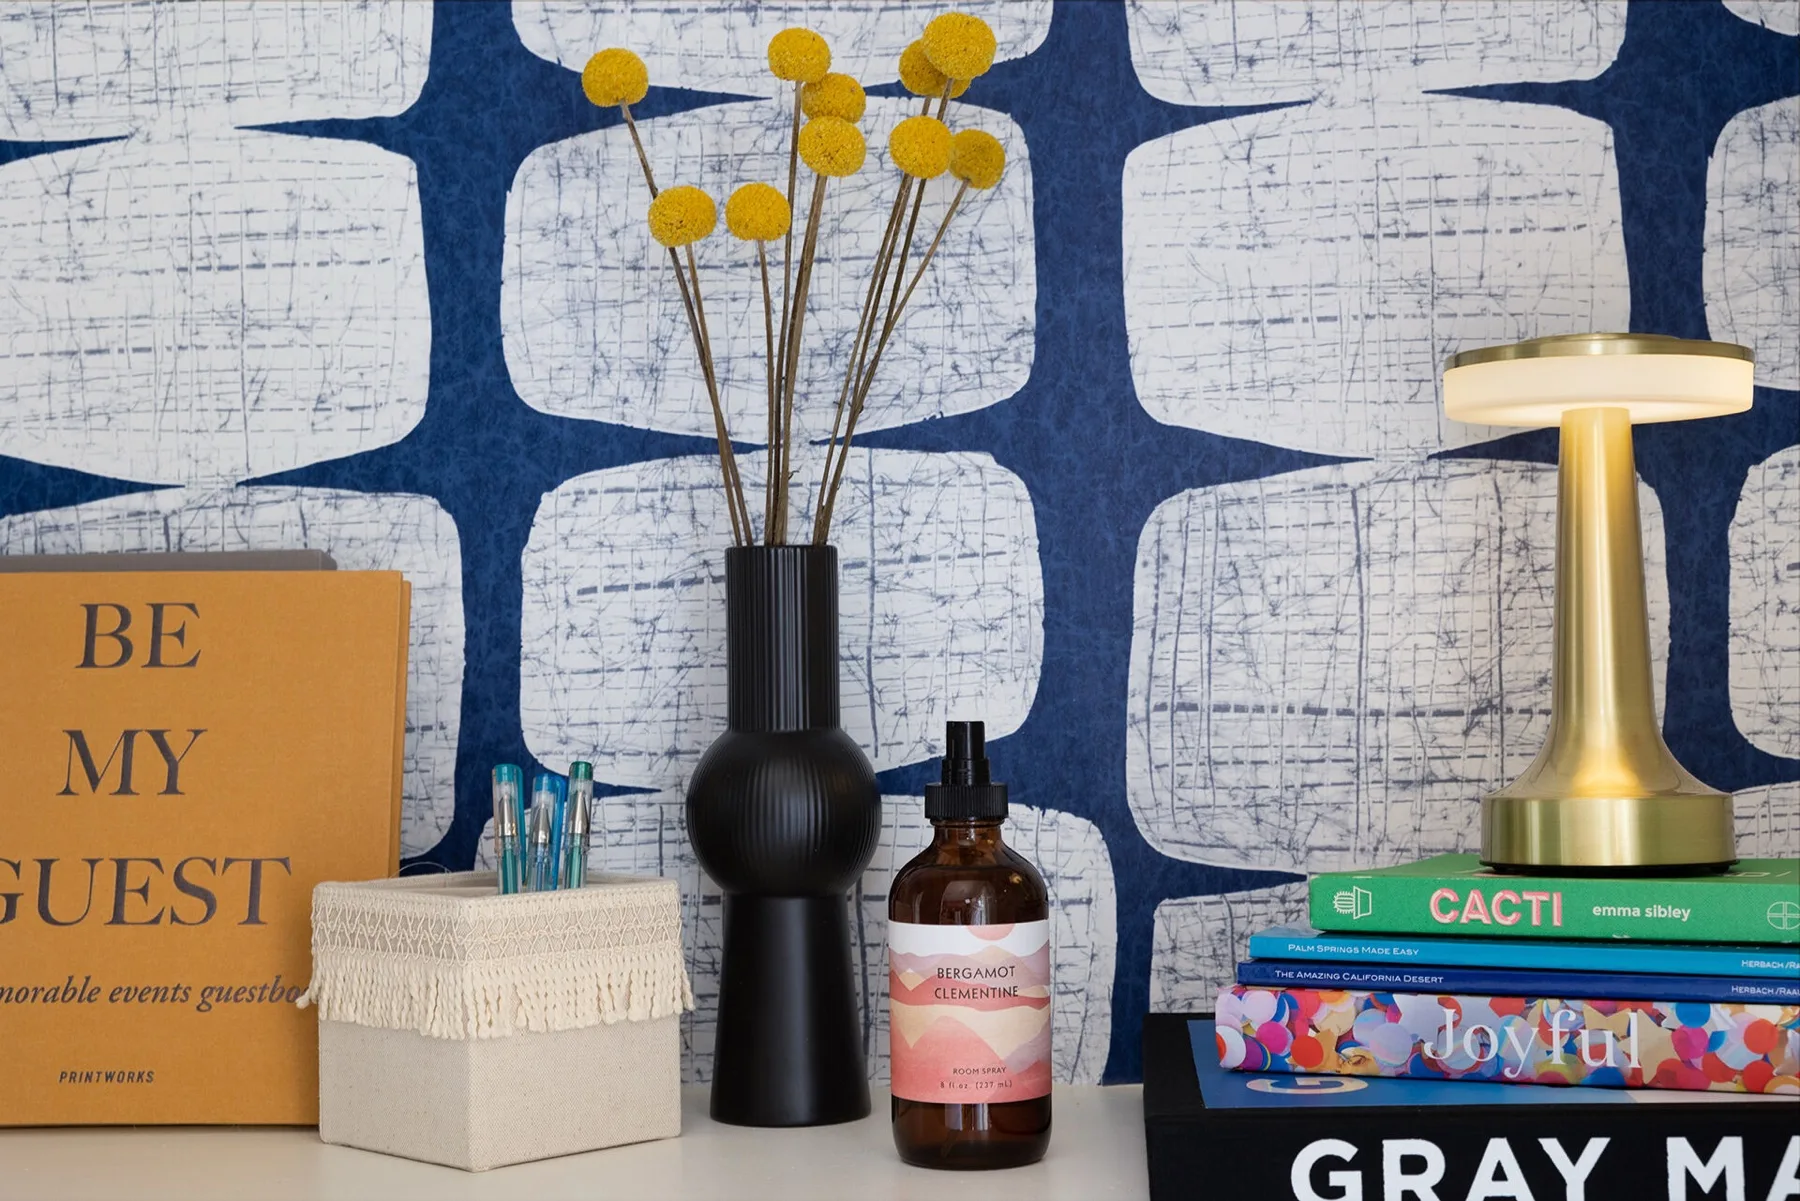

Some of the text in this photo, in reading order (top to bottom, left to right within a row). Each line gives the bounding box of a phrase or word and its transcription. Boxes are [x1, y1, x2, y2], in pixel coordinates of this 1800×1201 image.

[75, 602, 202, 669] BE
[55, 729, 208, 796] MY
[1429, 887, 1563, 927] CACTI
[1592, 904, 1692, 922] emma sibley
[1288, 943, 1419, 956] PALM SPRINGS MADE EASY
[937, 965, 1016, 980] BERGAMOT
[1741, 960, 1784, 969] HERBACH
[1275, 970, 1444, 984] THE AMAZING CALIFORNIA DESERT
[108, 983, 192, 1004] events
[196, 975, 309, 1012] guestbo
[934, 985, 1019, 999] CLEMENTINE
[1731, 985, 1774, 995] HERBACH
[1424, 1007, 1642, 1079] Joyful
[59, 1071, 155, 1084] PRINTWORKS
[1291, 1137, 1611, 1201] GRAY
